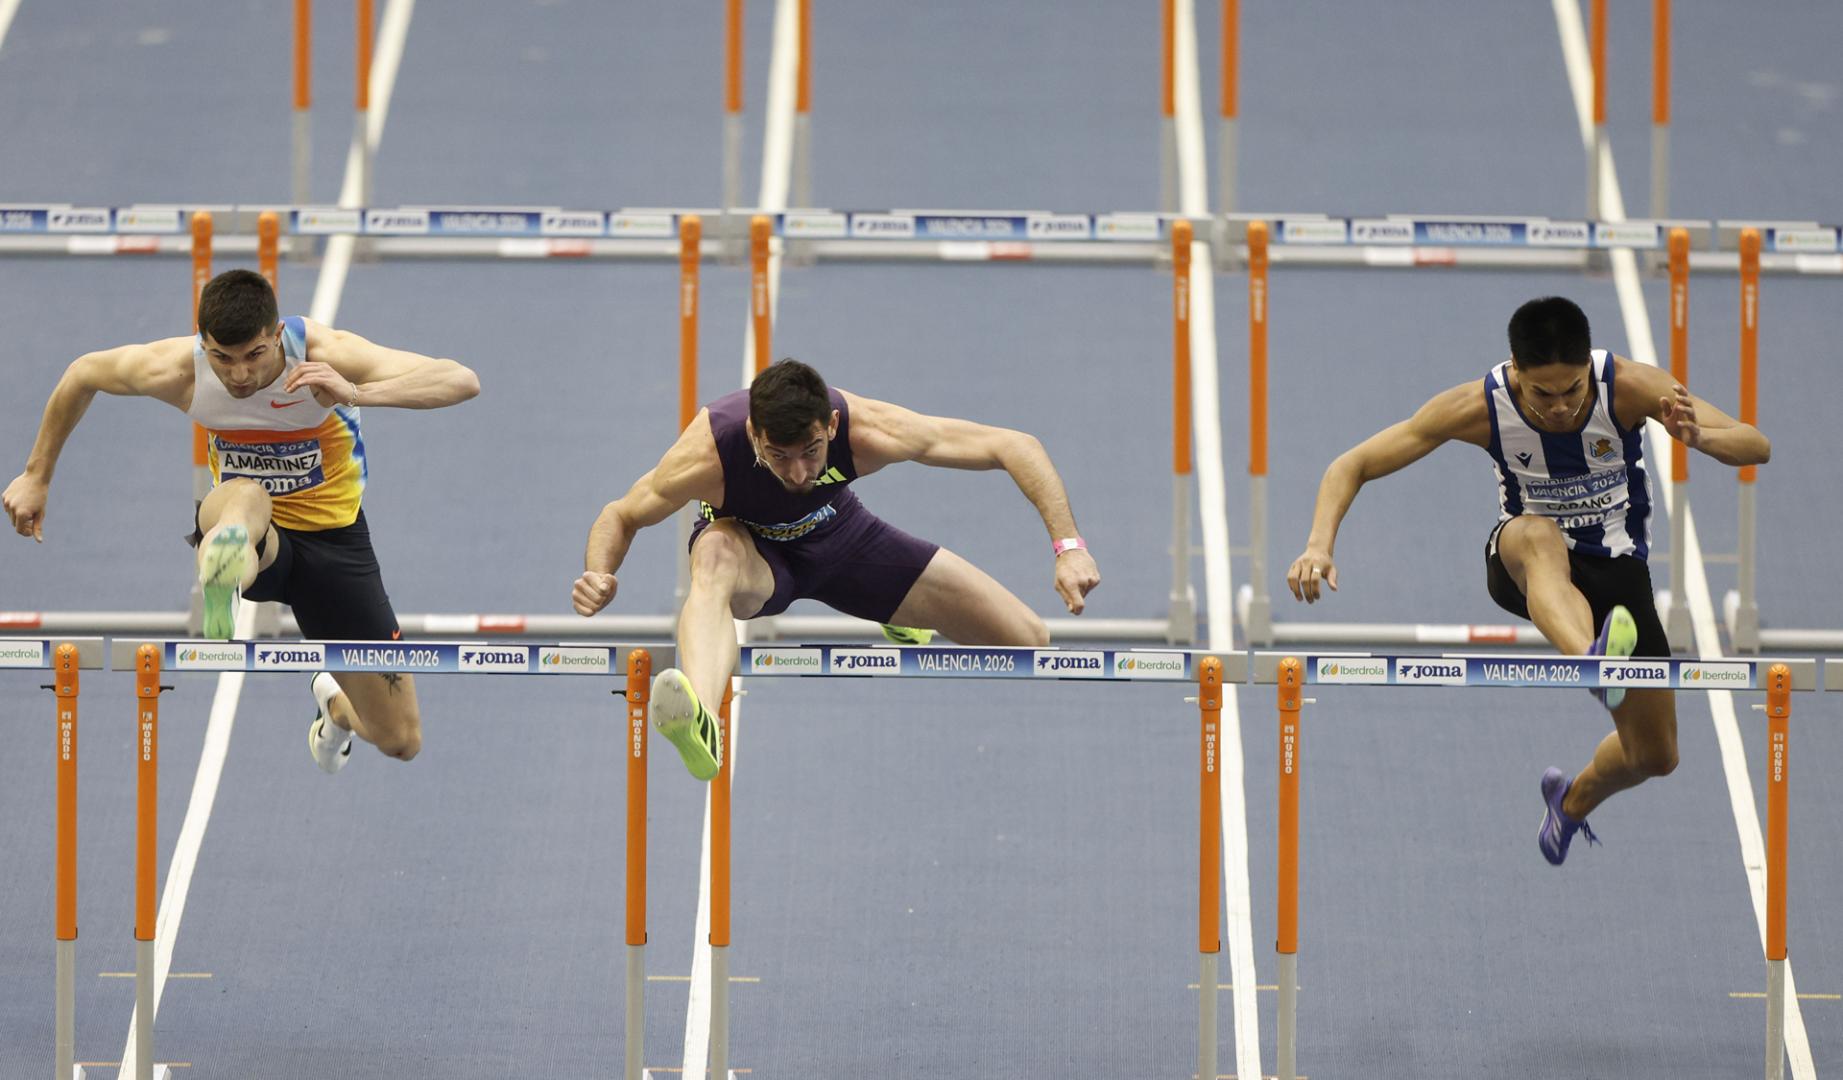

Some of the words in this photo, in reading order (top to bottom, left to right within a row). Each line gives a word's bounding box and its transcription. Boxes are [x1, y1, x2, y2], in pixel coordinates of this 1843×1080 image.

[225, 453, 318, 471] A.MARTINEZ
[198, 651, 243, 661] Iberdrola
[342, 649, 406, 667] VALENCIA
[409, 649, 440, 668] 2026
[561, 655, 606, 665] Iberdrola
[774, 655, 819, 666] Iberdrola
[917, 654, 982, 671] VALENCIA
[984, 655, 1015, 672] 2026
[1137, 660, 1182, 671] Iberdrola
[1340, 665, 1384, 676] Iberdrola
[1483, 664, 1547, 681] VALENCIA
[1550, 664, 1580, 682] 2026
[1702, 670, 1747, 681] Iberdrola
[62, 722, 72, 761] MONDO
[142, 722, 152, 761] MONDO
[632, 719, 643, 758] MONDO
[1206, 734, 1216, 773] MONDO
[1284, 735, 1294, 774] MONDO
[1774, 743, 1784, 782] MONDO
